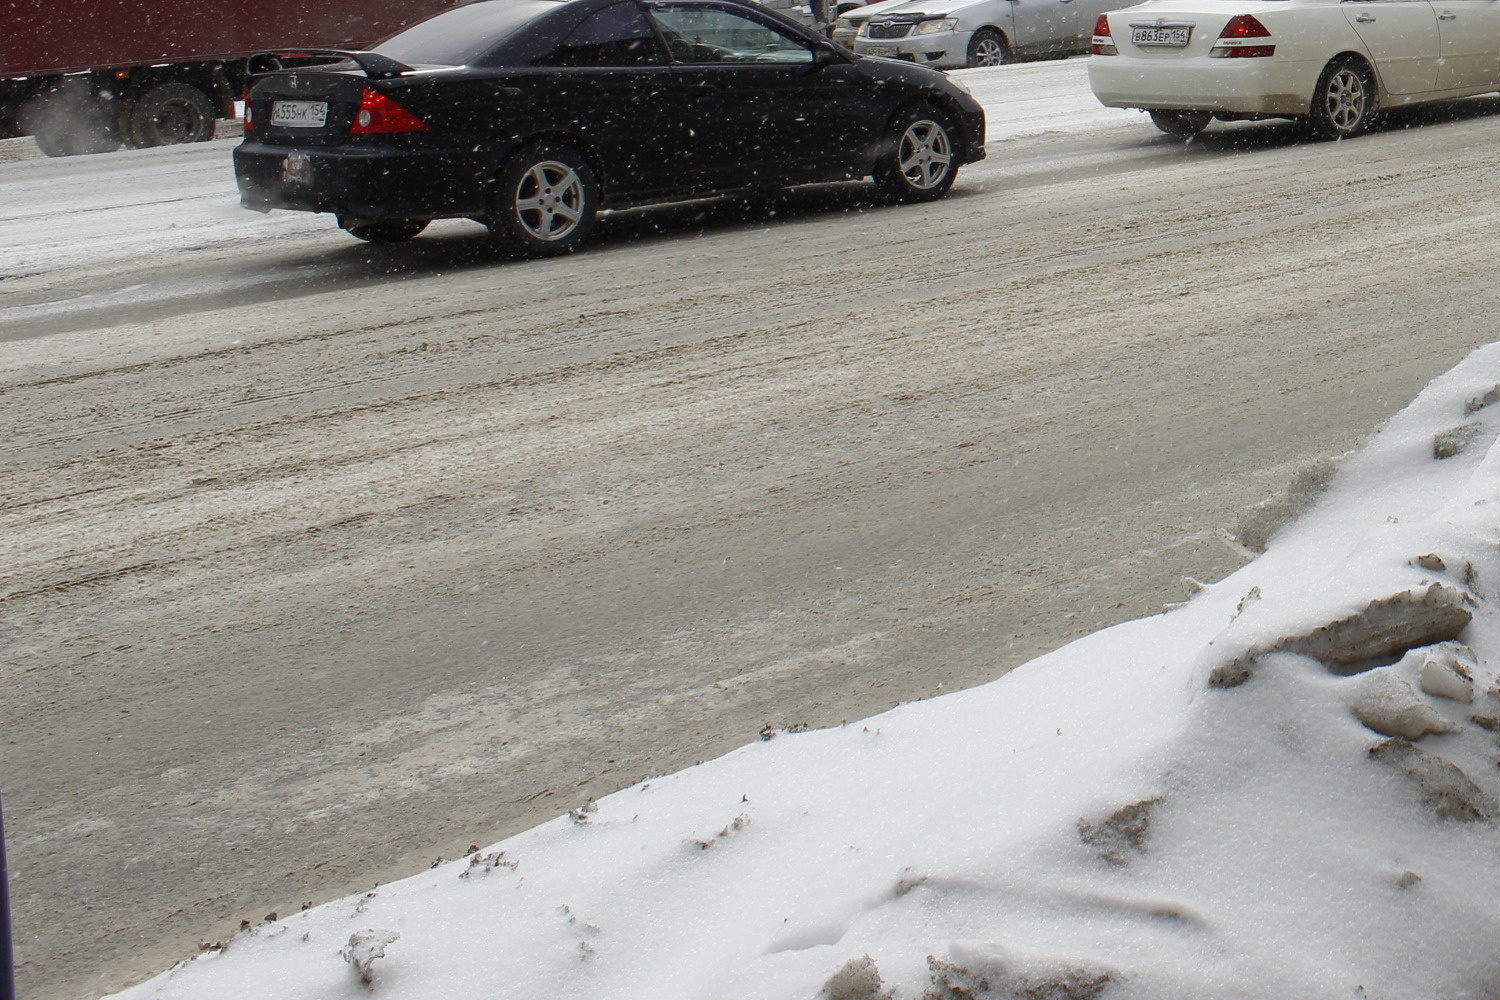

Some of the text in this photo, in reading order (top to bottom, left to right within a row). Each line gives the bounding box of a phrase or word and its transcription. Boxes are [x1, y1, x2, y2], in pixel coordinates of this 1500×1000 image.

[1135, 29, 1186, 43] В863ЕР 154
[273, 104, 307, 120] А555НК
